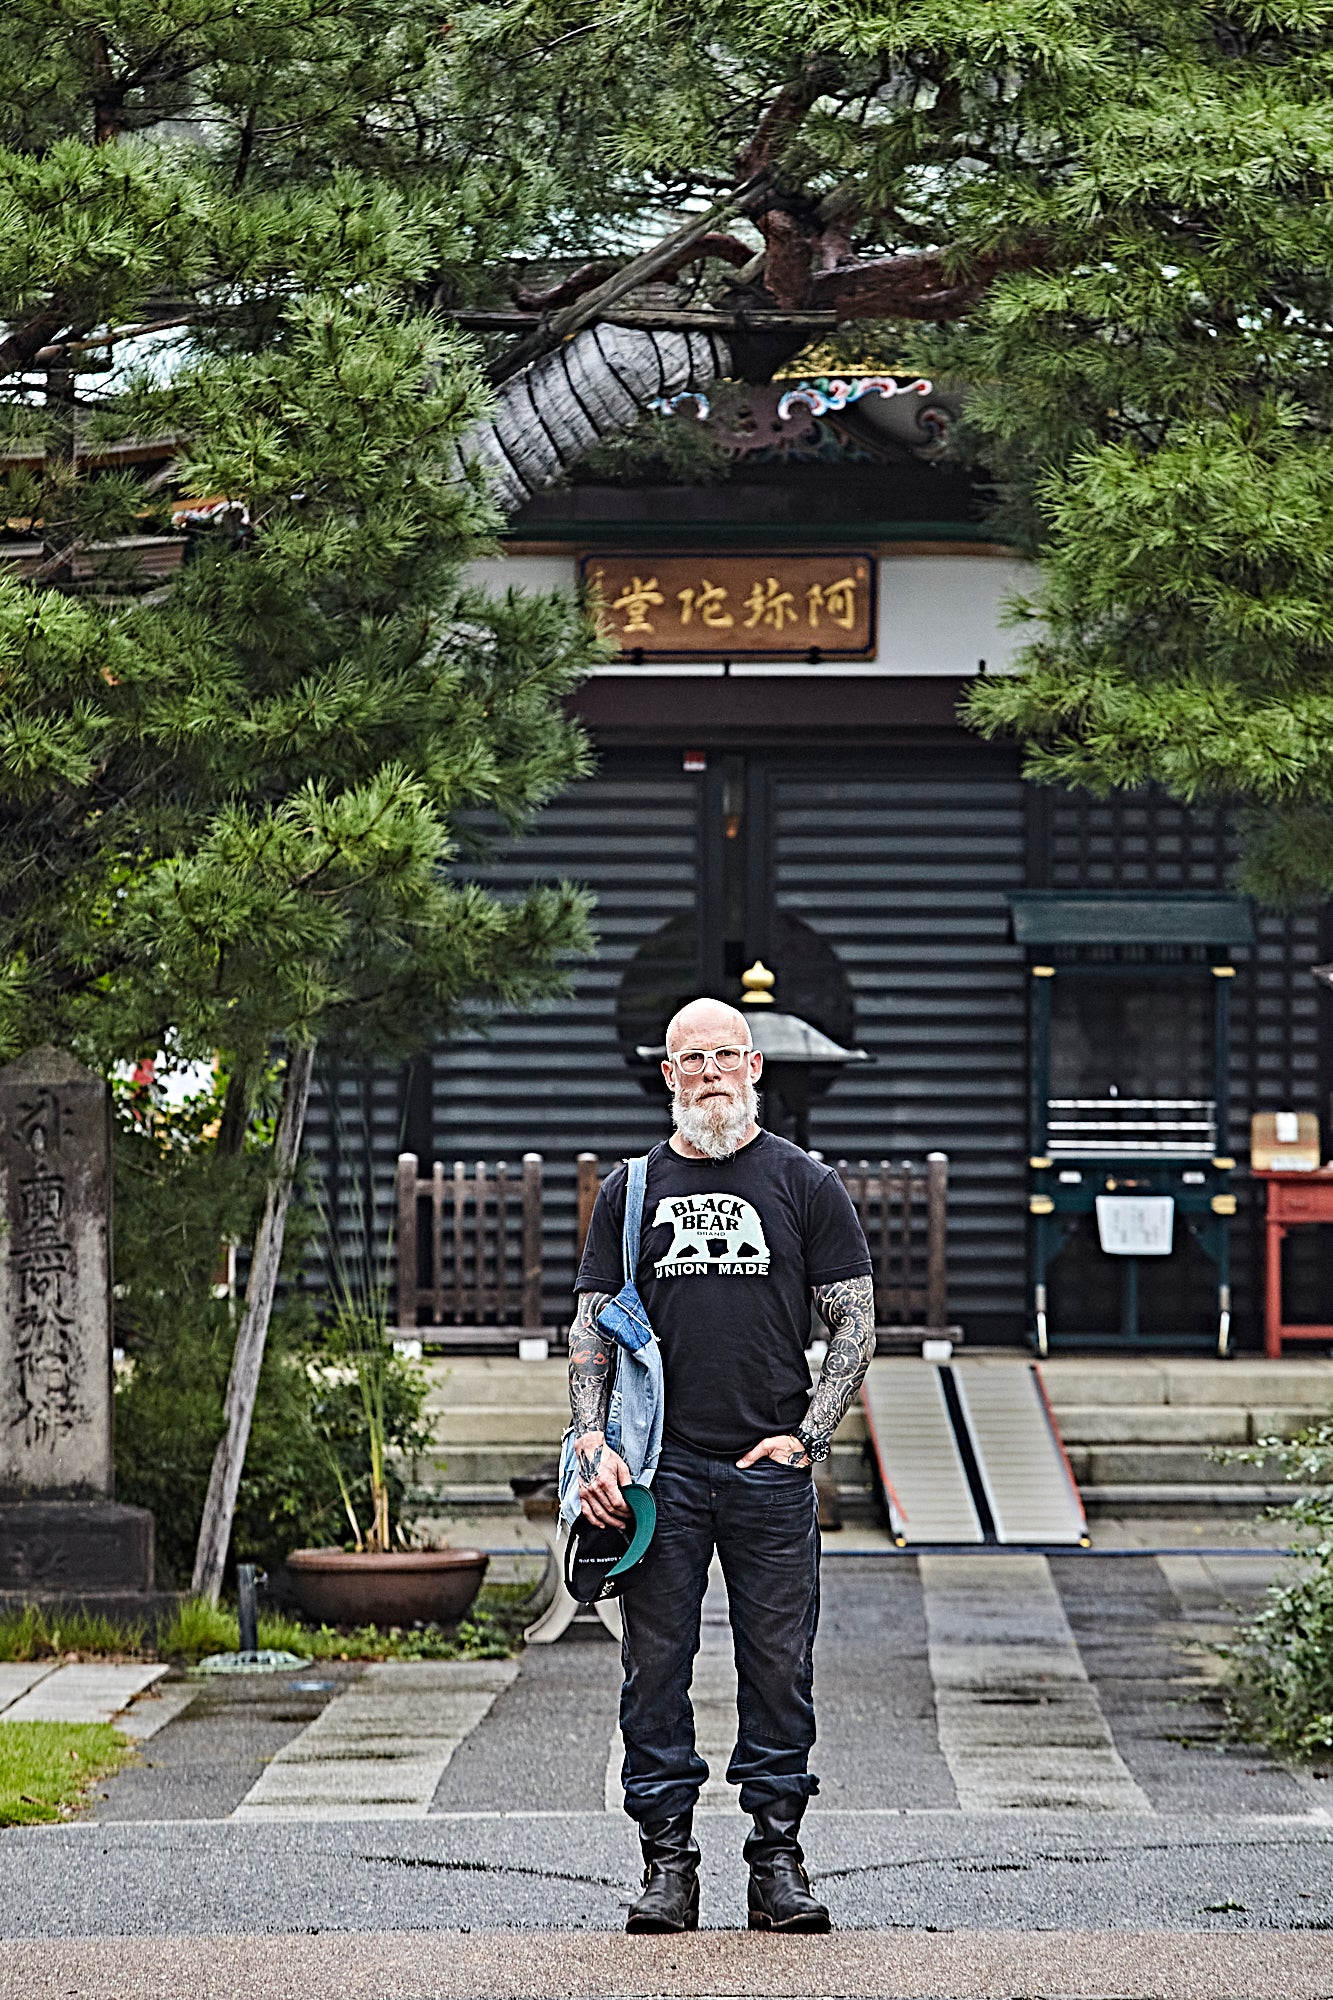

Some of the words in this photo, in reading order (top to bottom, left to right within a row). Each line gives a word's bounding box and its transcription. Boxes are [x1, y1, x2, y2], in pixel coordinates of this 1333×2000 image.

[671, 1198, 746, 1219] BLACK
[682, 1213, 740, 1231] BEAR
[656, 1263, 708, 1279] UNION
[718, 1263, 769, 1276] MADE
